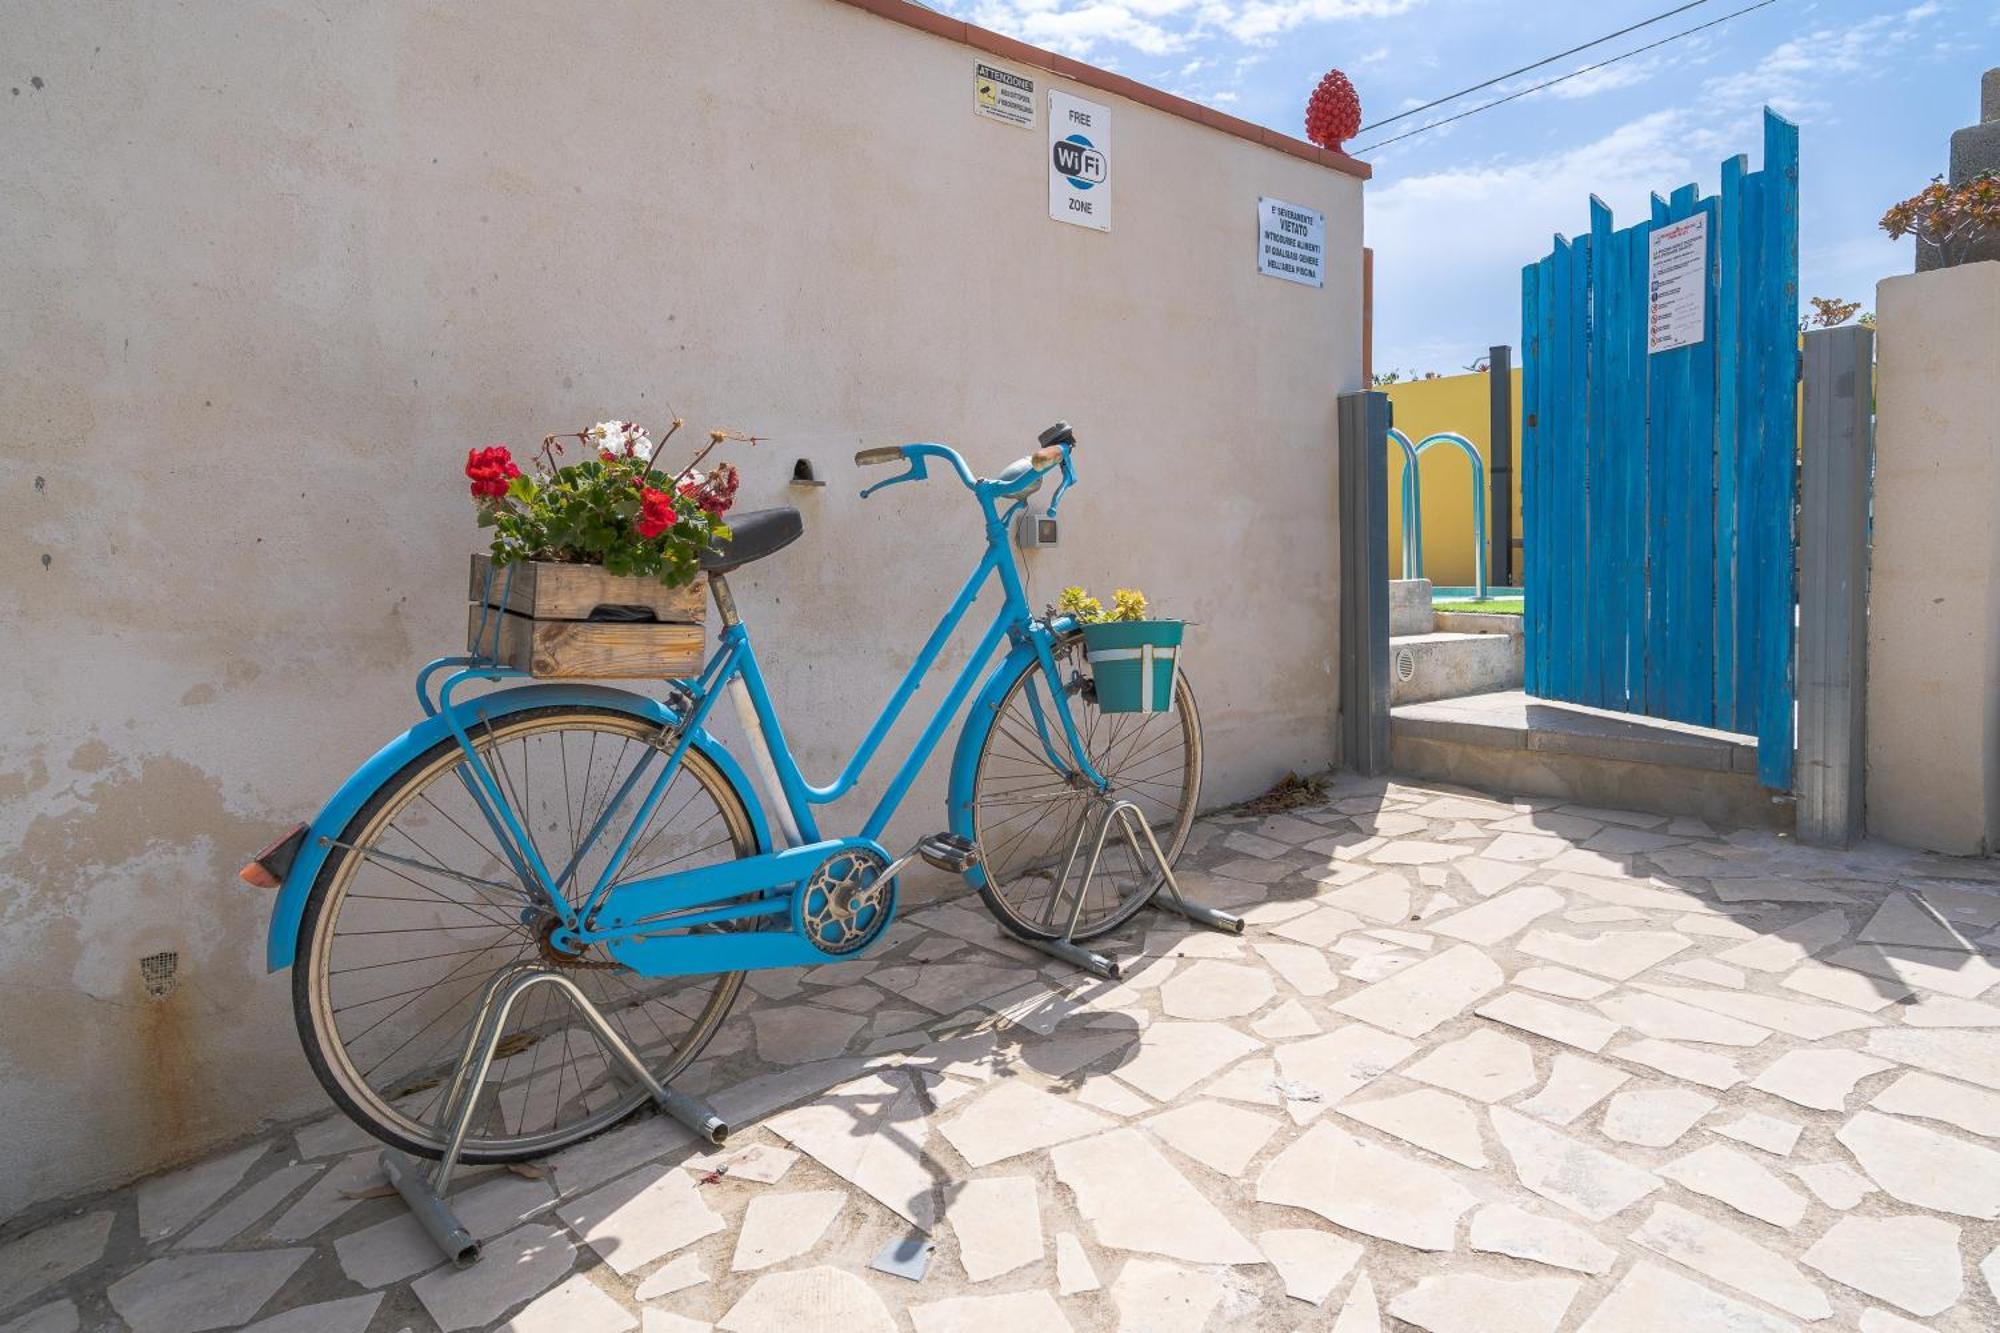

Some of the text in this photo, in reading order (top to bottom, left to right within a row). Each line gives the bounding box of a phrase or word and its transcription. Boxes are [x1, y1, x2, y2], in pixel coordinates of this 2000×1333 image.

[1069, 110, 1092, 127] FREE
[1069, 198, 1093, 215] ZONE
[1278, 207, 1313, 225] SEVERAMENTE
[1280, 218, 1308, 237] VIETATO
[1264, 231, 1321, 254] INTRODURRE ALIMENTI
[1295, 265, 1316, 278] PISCINA
